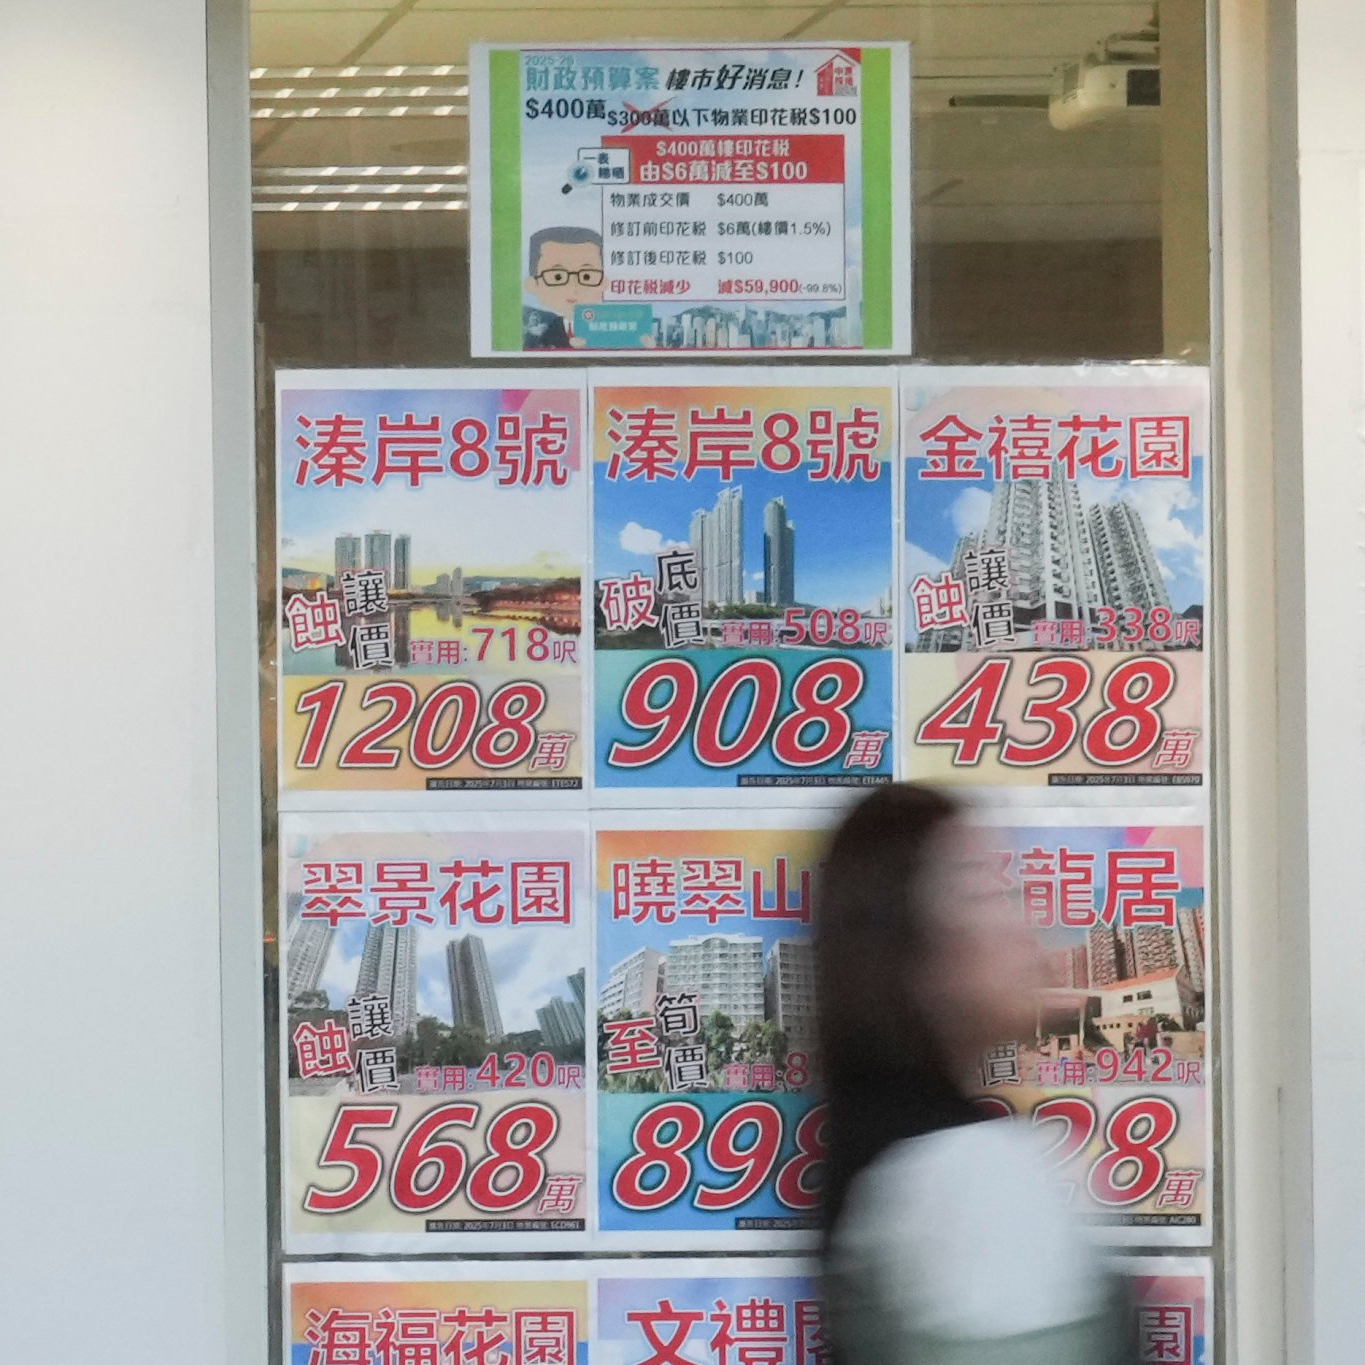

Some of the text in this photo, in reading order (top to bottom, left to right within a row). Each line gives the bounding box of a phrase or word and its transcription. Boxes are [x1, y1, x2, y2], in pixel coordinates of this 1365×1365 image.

[525, 64, 804, 92] 財政預算案 樓市好消息!
[525, 98, 606, 120] $400萬
[610, 192, 769, 208] 物業成交價 $400萬
[718, 251, 753, 265] $100
[293, 413, 569, 488] 溱岸8號
[606, 407, 881, 483] 溱岸8號
[919, 414, 1191, 480] 金禧花園
[409, 628, 578, 665] 實用:718呎
[721, 609, 892, 647] 實用:508呎
[1031, 608, 1201, 646] 實用:338呎
[295, 679, 575, 771] 1208萬
[608, 656, 890, 769] 908萬
[916, 656, 1198, 768] 438萬
[301, 859, 573, 927] 翠景花園
[611, 857, 813, 925] 曉翠山
[415, 1052, 582, 1090] 實用:420呎
[304, 1102, 582, 1215] 568萬
